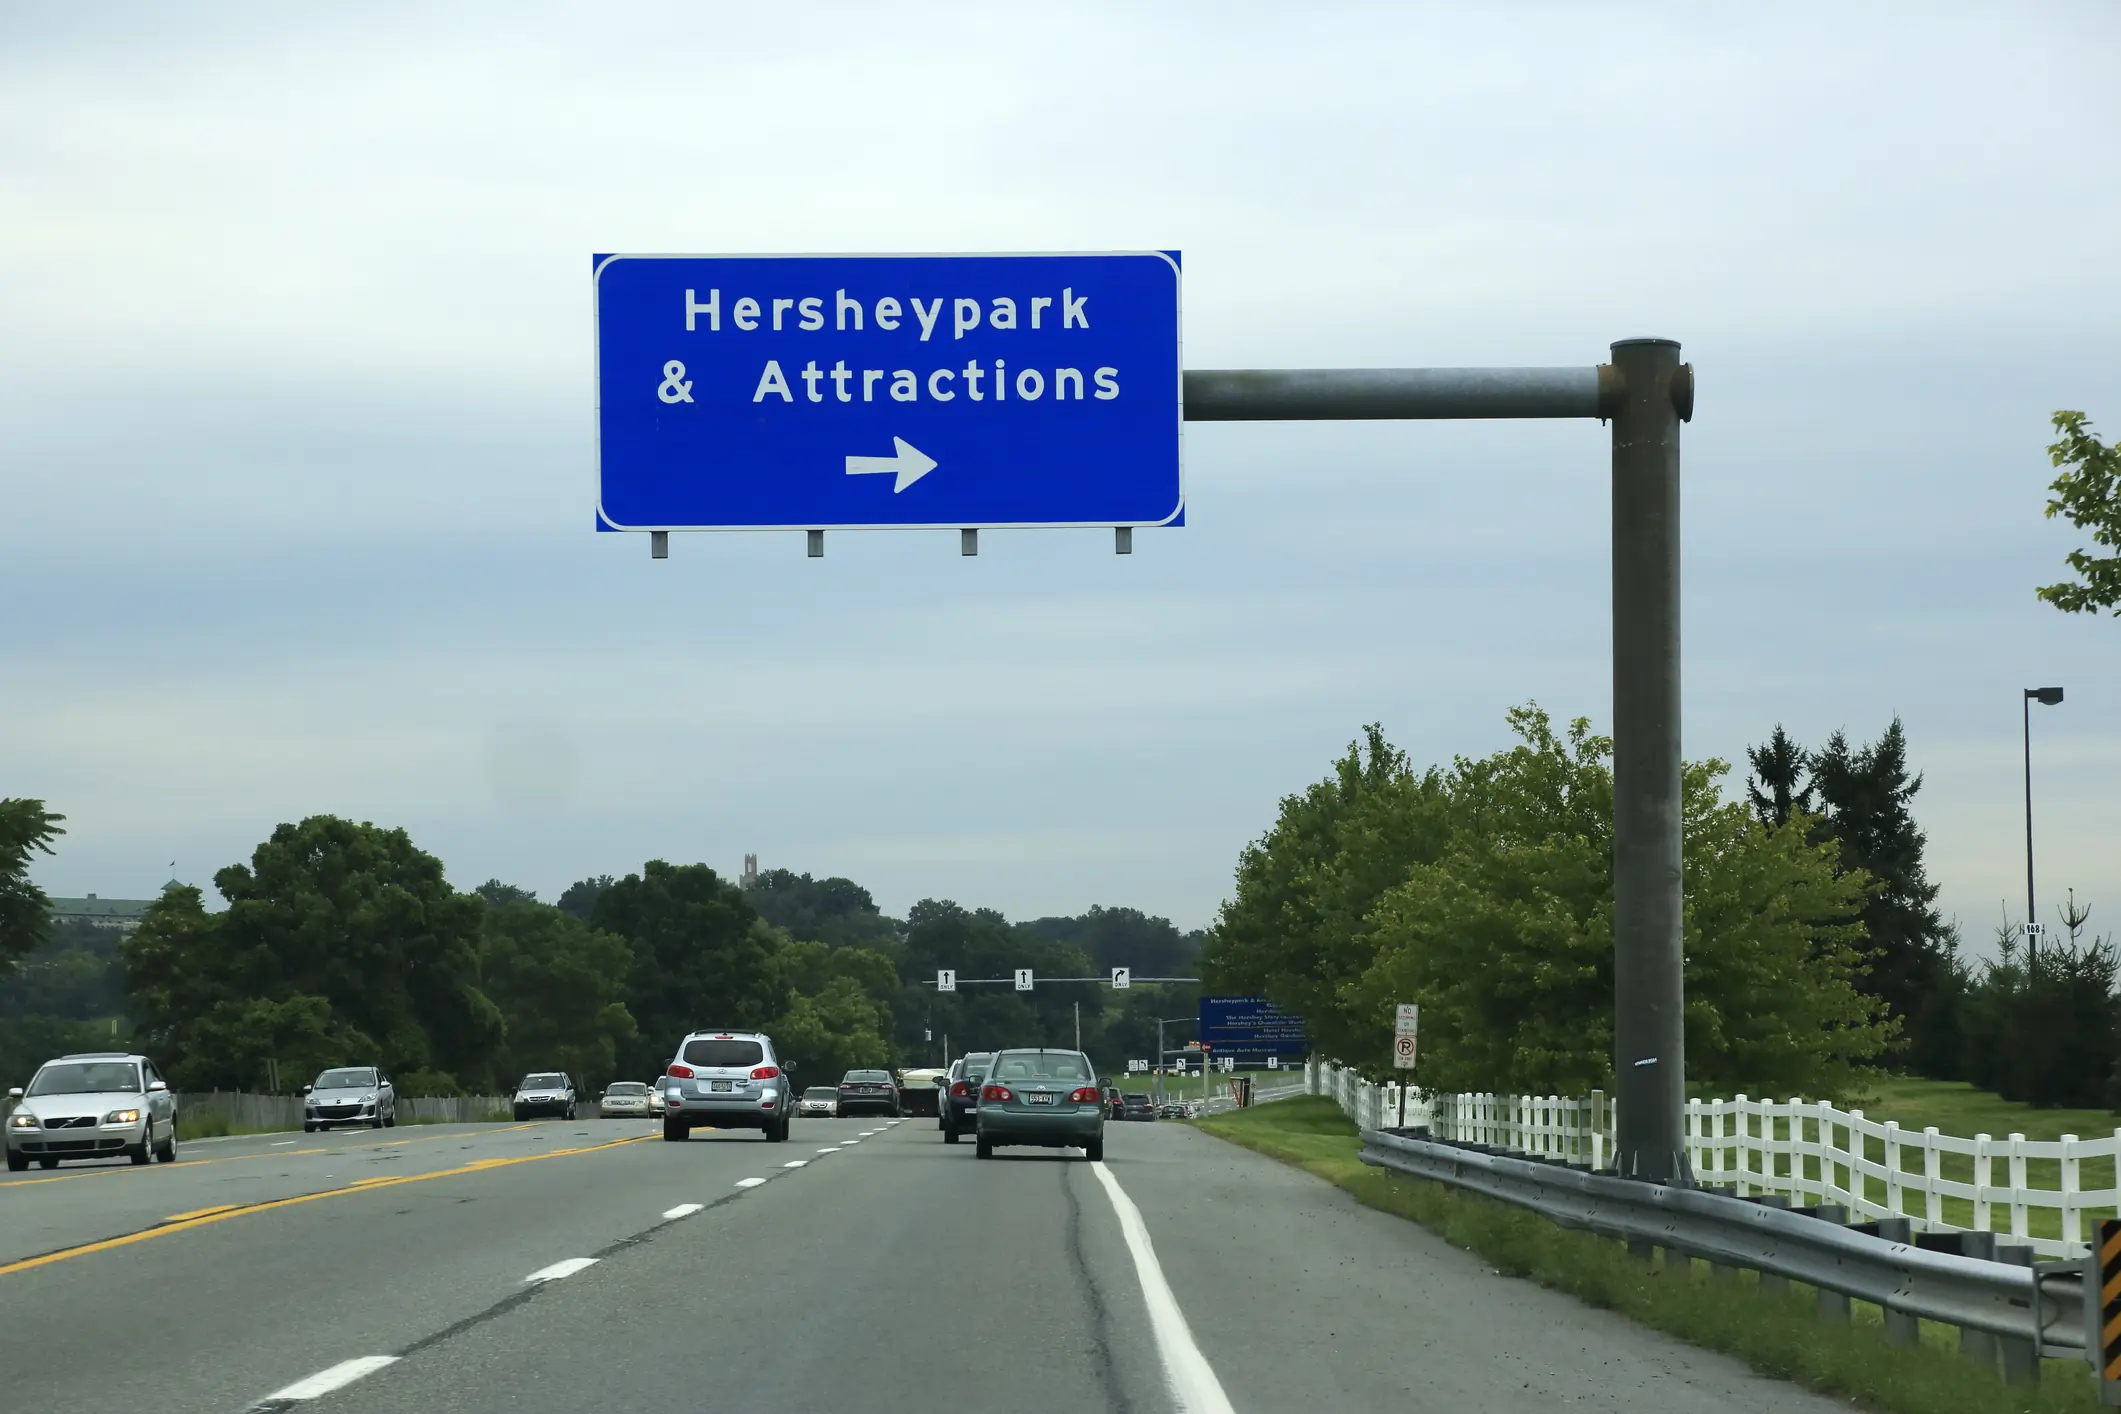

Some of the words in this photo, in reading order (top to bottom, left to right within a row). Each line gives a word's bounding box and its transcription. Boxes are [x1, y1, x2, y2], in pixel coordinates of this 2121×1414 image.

[685, 287, 1090, 341] Hersheypark
[657, 358, 694, 404] &
[753, 359, 1120, 403] Attractions
[2027, 925, 2040, 934] 168
